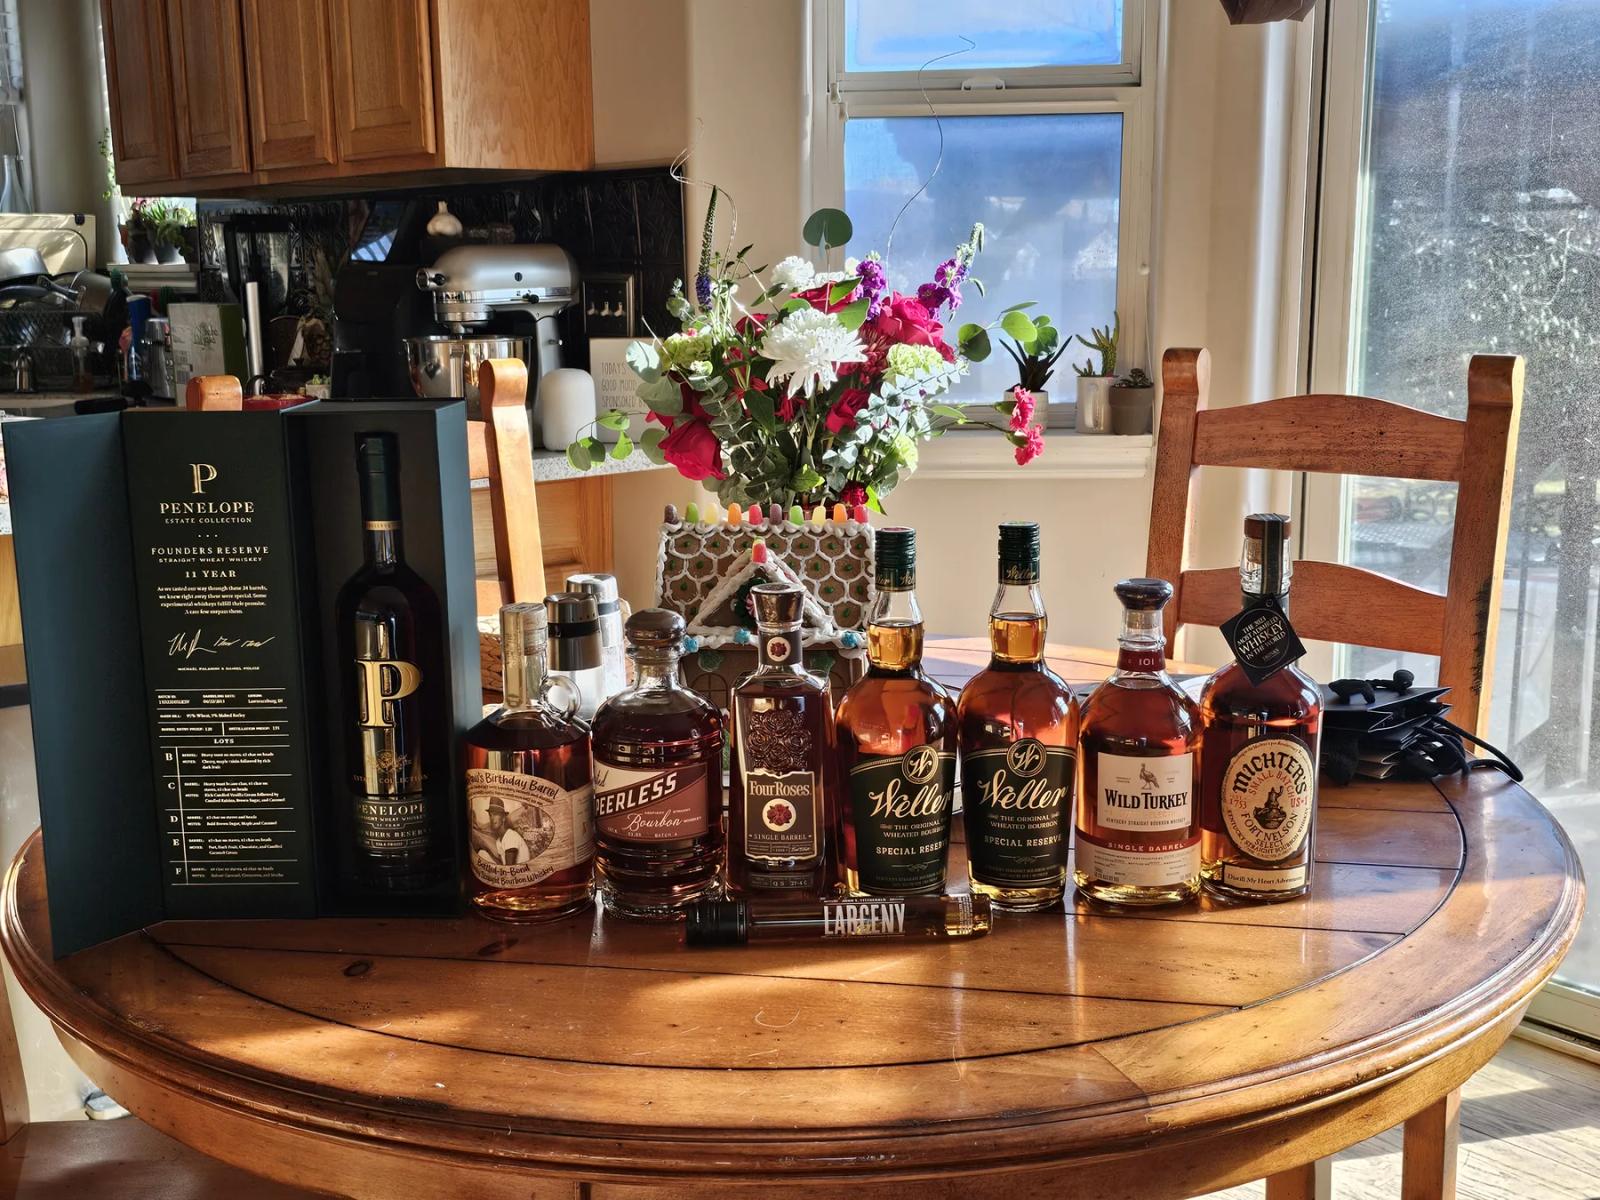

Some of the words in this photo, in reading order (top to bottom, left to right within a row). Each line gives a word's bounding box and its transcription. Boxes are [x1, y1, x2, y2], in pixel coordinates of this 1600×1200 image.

[160, 501, 255, 514] PENELOPE
[152, 547, 213, 556] FOUNDERS
[217, 546, 270, 554] RESERVE
[202, 570, 237, 578] YEAR
[1238, 621, 1284, 654] WHISKEY
[165, 752, 173, 760] B
[1232, 752, 1308, 795] MICHTER'S
[485, 772, 528, 790] Birthday
[528, 780, 560, 800] Barrel
[976, 768, 1068, 810] Weller
[1248, 770, 1274, 796] SMALL
[1276, 770, 1295, 800] BATCH
[595, 772, 678, 816] PEERLESS
[868, 778, 951, 818] Weller
[1104, 788, 1140, 809] WILD
[1140, 791, 1188, 810] TURKEY
[359, 803, 425, 816] ENELOP
[622, 808, 682, 832] Bourbon
[910, 820, 940, 830] ORIGINAL
[1028, 820, 1058, 830] BOURBON
[1240, 812, 1263, 838] FORT
[1264, 812, 1298, 841] NELSON
[920, 826, 945, 837] BOURB
[876, 846, 916, 856] SPECIAL
[920, 840, 946, 854] RESER
[985, 834, 1023, 847] SPECIAL
[1108, 842, 1144, 852] SINGLE
[1148, 843, 1184, 852] BARREL
[1254, 838, 1283, 849] SELECT
[824, 904, 905, 935] LARCENY
